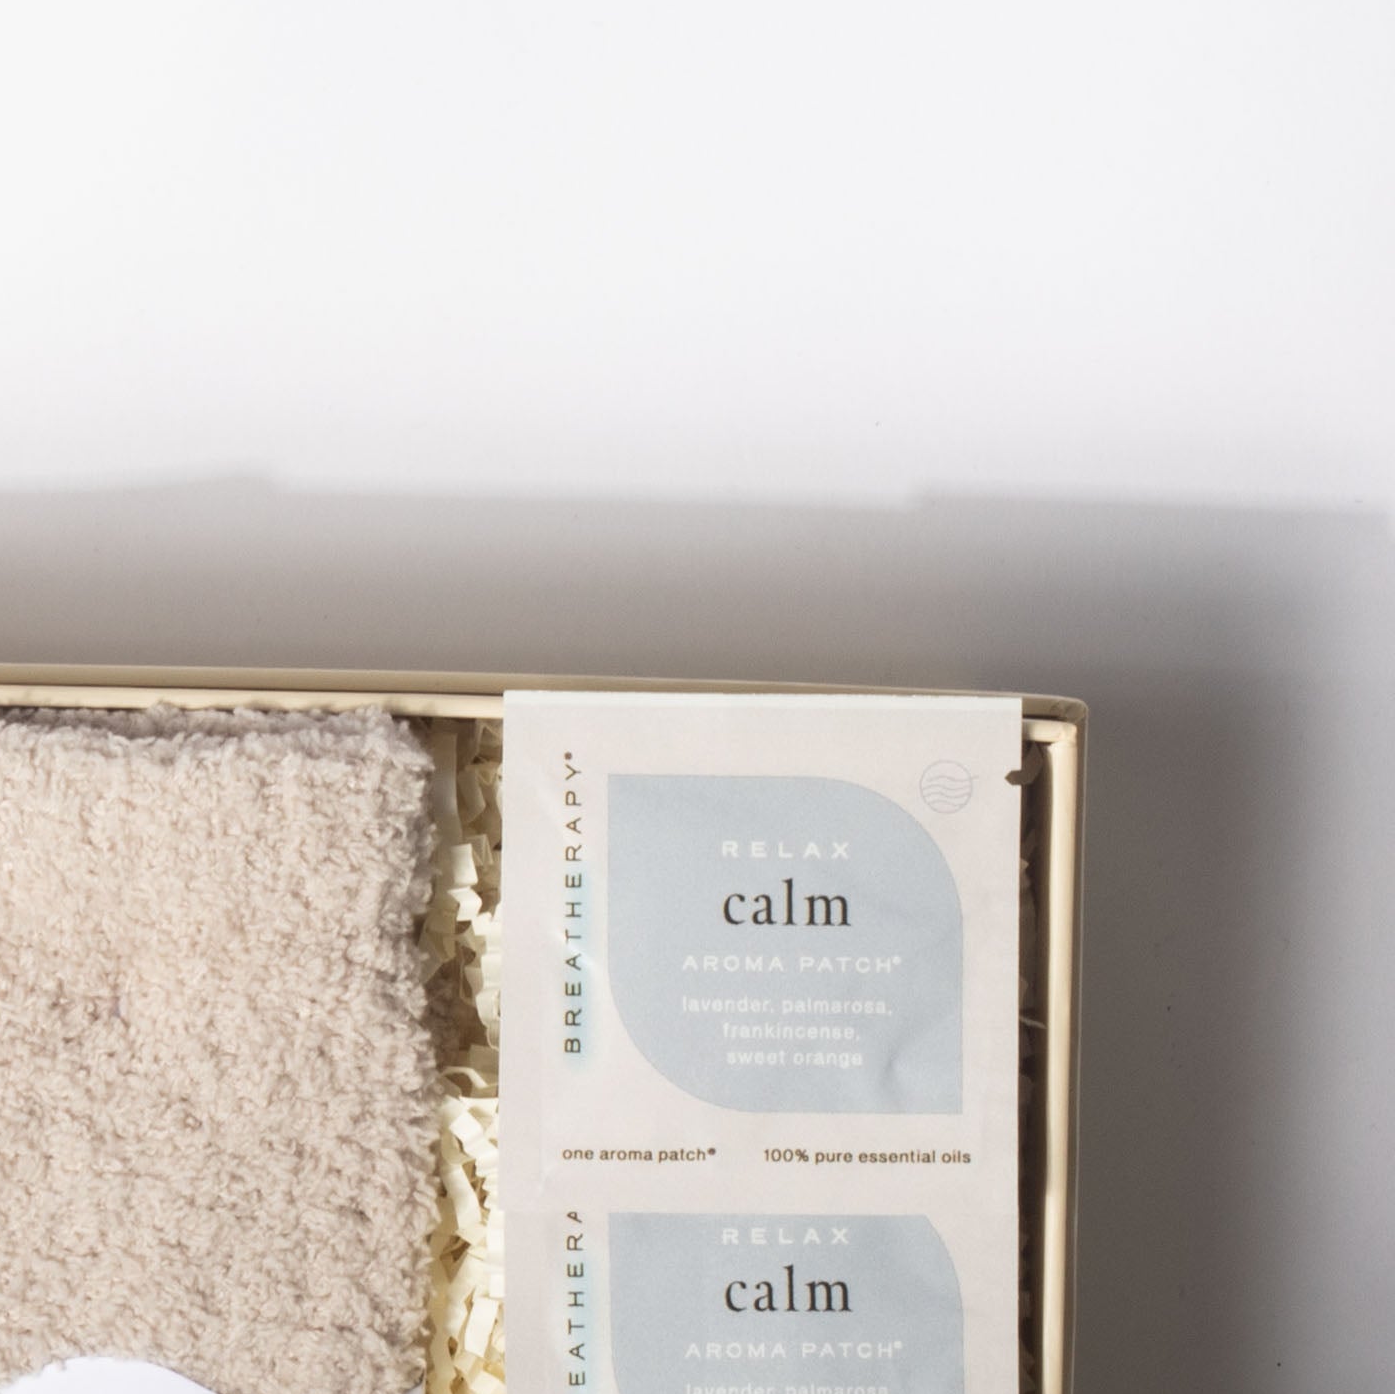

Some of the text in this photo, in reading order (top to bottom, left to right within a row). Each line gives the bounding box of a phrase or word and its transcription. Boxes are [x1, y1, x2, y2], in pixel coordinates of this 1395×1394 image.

[722, 840, 849, 859] RELAX
[722, 878, 852, 927] calm
[682, 955, 785, 973] AROMA
[682, 995, 893, 1016] lavender, palmarosa,
[722, 1022, 860, 1042] frankincense,
[726, 1049, 863, 1068] sweet orange
[562, 1149, 594, 1160] one
[599, 1149, 654, 1161] aroma
[763, 1148, 972, 1166] 100% pure essential oils
[722, 1228, 849, 1245] RELAX
[724, 1265, 853, 1313] calm
[684, 1342, 787, 1359] AROMA
